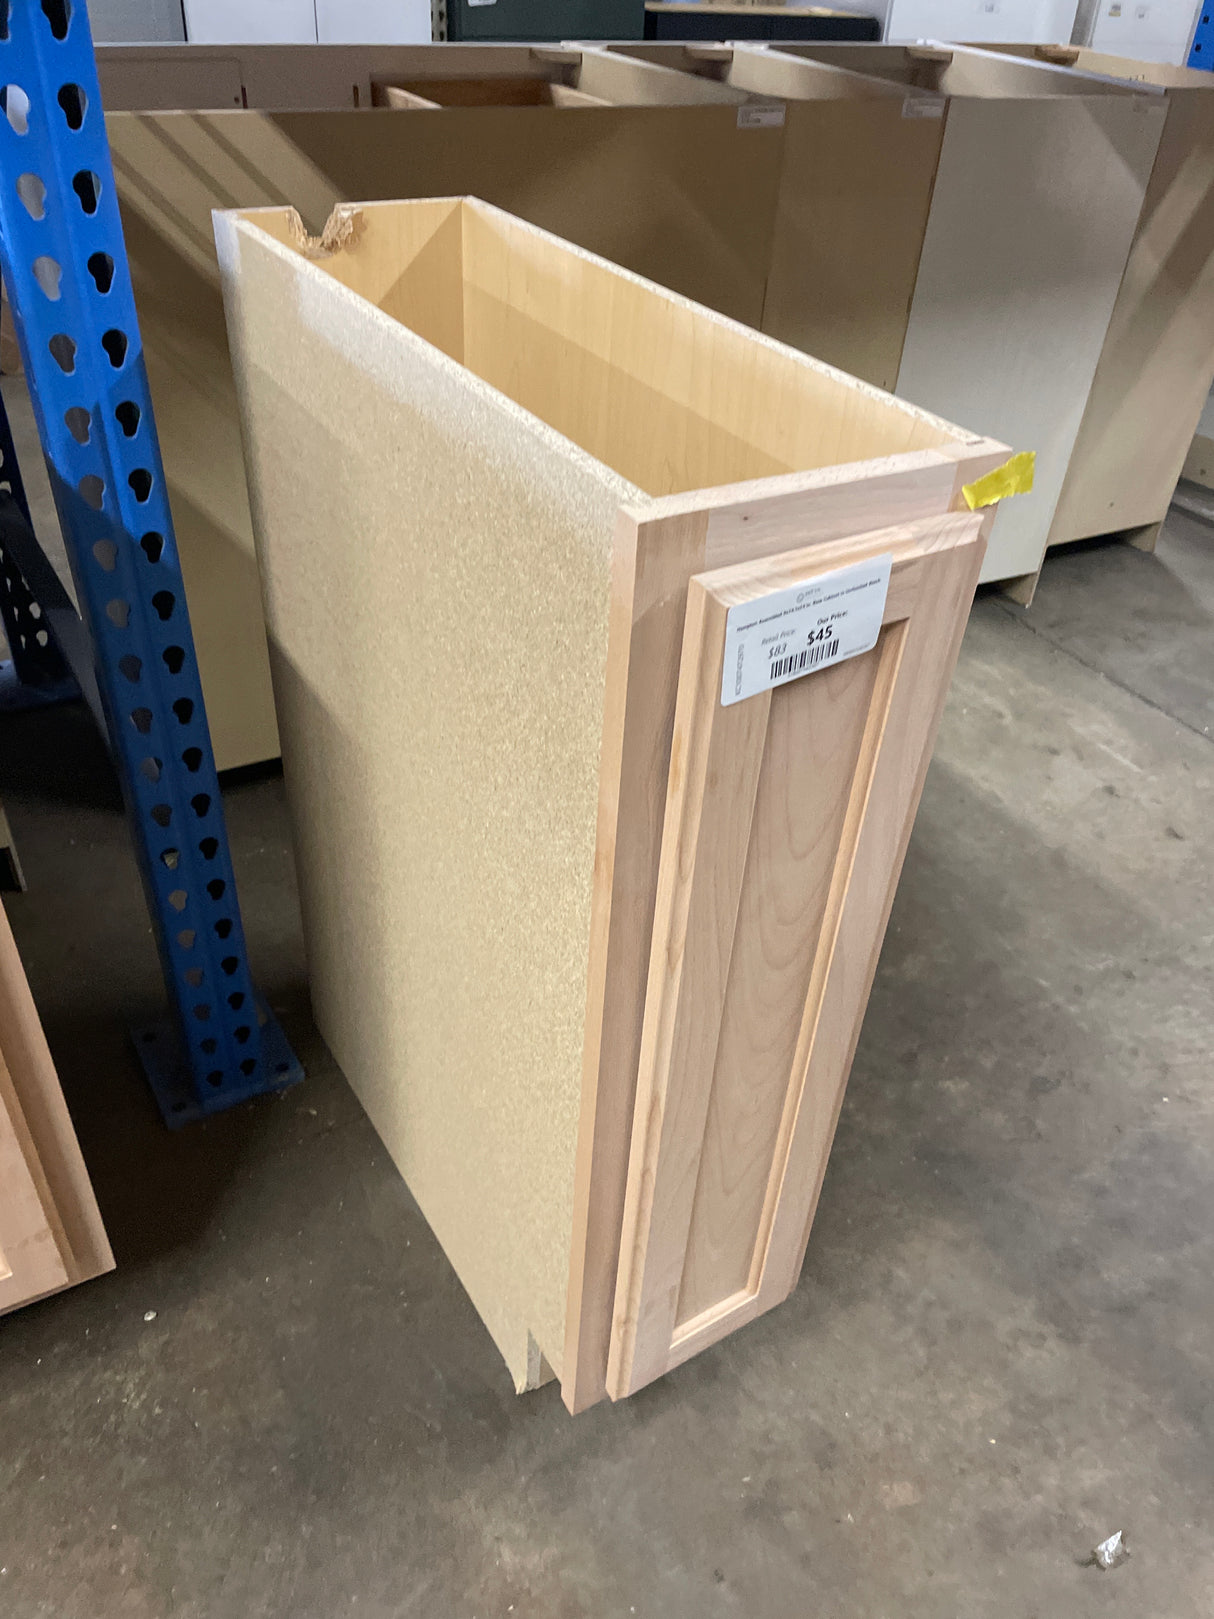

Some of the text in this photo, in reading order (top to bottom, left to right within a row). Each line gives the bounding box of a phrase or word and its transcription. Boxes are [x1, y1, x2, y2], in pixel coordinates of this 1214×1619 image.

[817, 609, 848, 626] Our Price:
[761, 632, 779, 645] Retail
[807, 625, 833, 647] $45
[768, 642, 788, 660] $83
